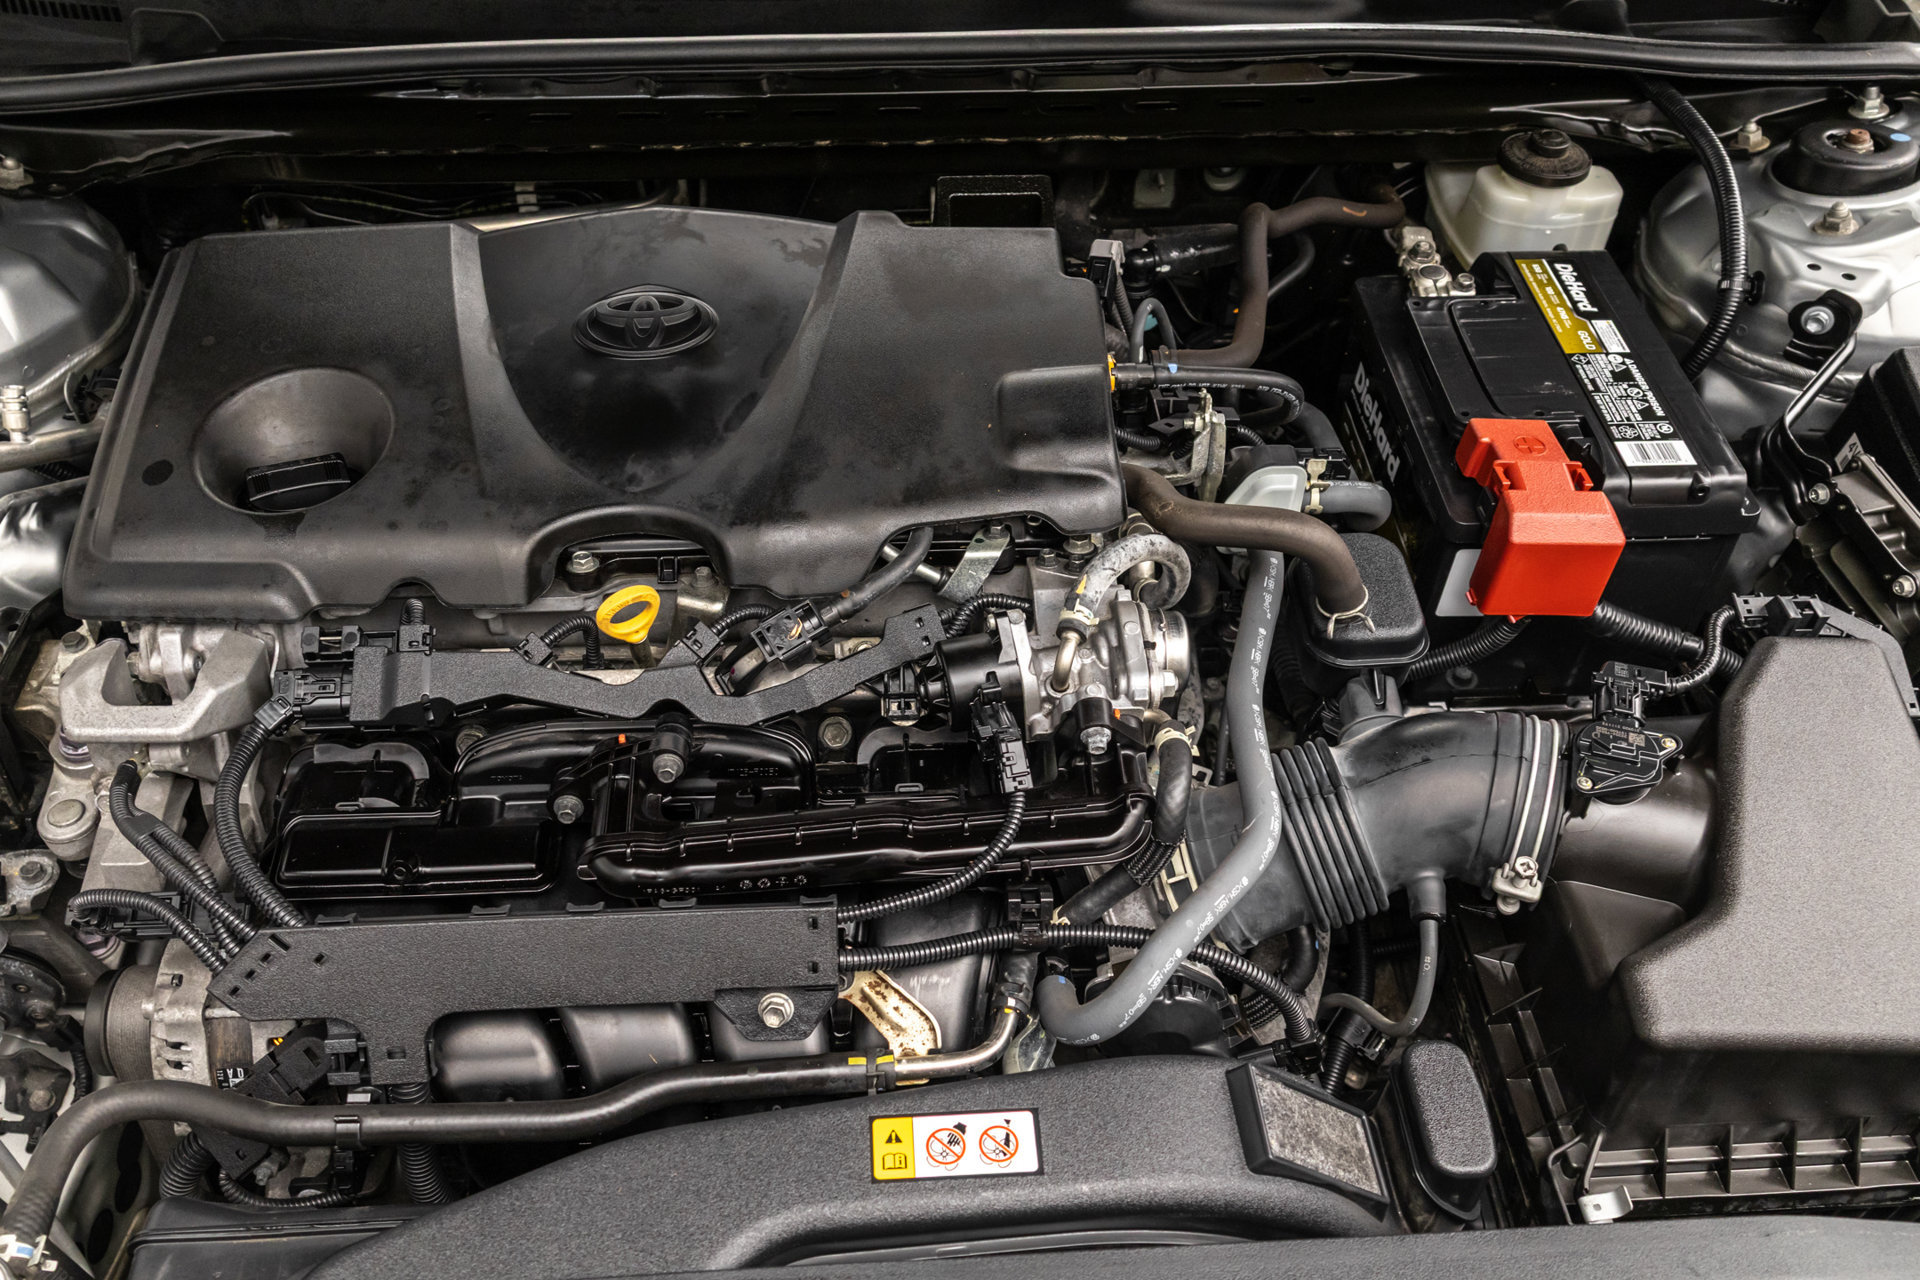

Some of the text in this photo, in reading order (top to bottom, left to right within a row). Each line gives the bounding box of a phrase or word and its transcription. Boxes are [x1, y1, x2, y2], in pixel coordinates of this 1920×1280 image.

[1554, 263, 1599, 312] DieHard
[1577, 330, 1597, 351] GOLD
[1354, 361, 1401, 483] DieHard
